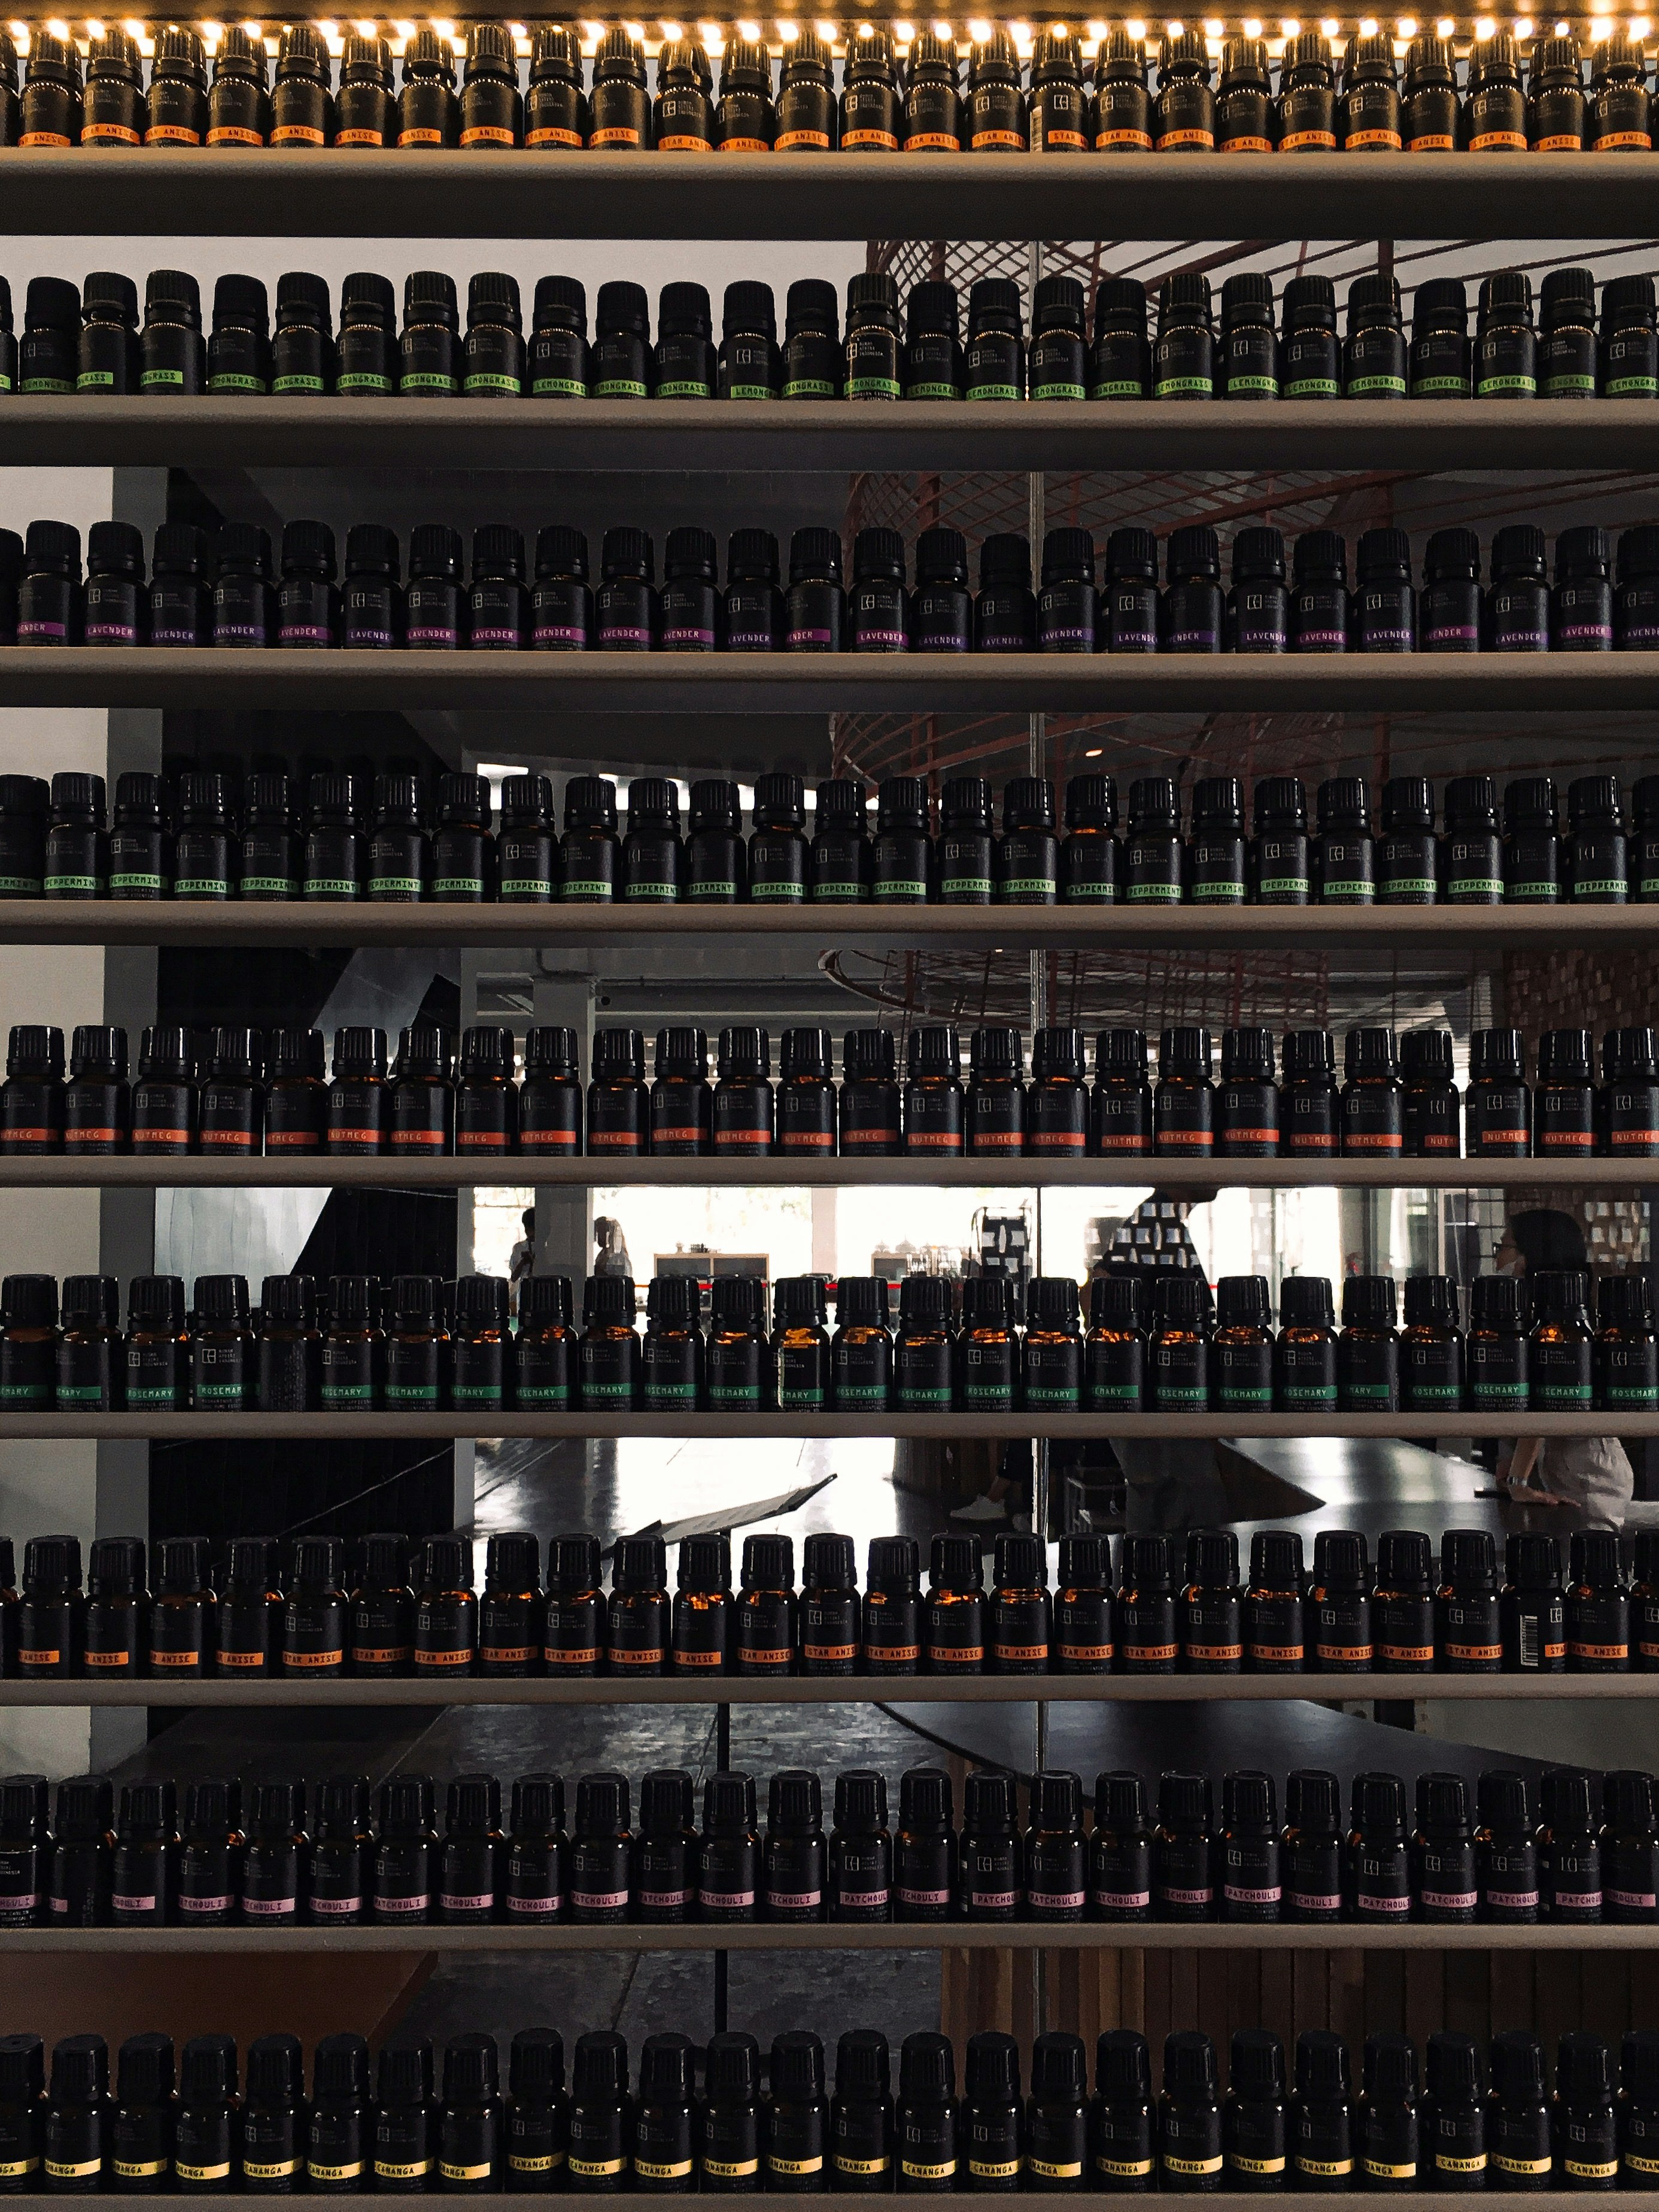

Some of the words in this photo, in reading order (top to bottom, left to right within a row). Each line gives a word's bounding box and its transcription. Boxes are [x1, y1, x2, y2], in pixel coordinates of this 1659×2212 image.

[479, 129, 506, 138] ANISE
[88, 627, 133, 636] LAVENDER
[214, 627, 254, 636] LAVENDER
[408, 630, 451, 639] LAVENDER
[472, 631, 513, 640] LAVENDER
[1041, 630, 1083, 642] LAVENDER
[1367, 632, 1410, 640] LAVENDER
[729, 634, 769, 643] LAVENDER
[861, 632, 903, 642] LAVENDER
[1300, 633, 1342, 642] LAVENDER
[1496, 634, 1540, 644] LAVENDER
[1129, 886, 1180, 894] PEPPERMINT
[1107, 1137, 1143, 1145] NUTMEG
[128, 1389, 172, 1398] ROSEMARY
[443, 1652, 469, 1661] ANISE
[631, 1652, 658, 1660] ANISE
[764, 1651, 789, 1660] ANISE
[952, 1650, 979, 1658] ANISE
[1152, 1648, 1175, 1656] ANISE
[1216, 1648, 1239, 1657] ANISE
[1350, 1649, 1372, 1657] ANISE
[1450, 1648, 1471, 1657] STAR
[1594, 1648, 1621, 1656] ANISE
[308, 1655, 336, 1663] ANISE
[1031, 1894, 1077, 1904] PATCHOULI
[1168, 2158, 1205, 2171] CANANGA
[1442, 2158, 1480, 2168] CANANGA
[907, 2165, 944, 2175] CANANGA
[974, 2164, 1012, 2174] CANANGA
[1570, 2164, 1610, 2174] CANANGA
